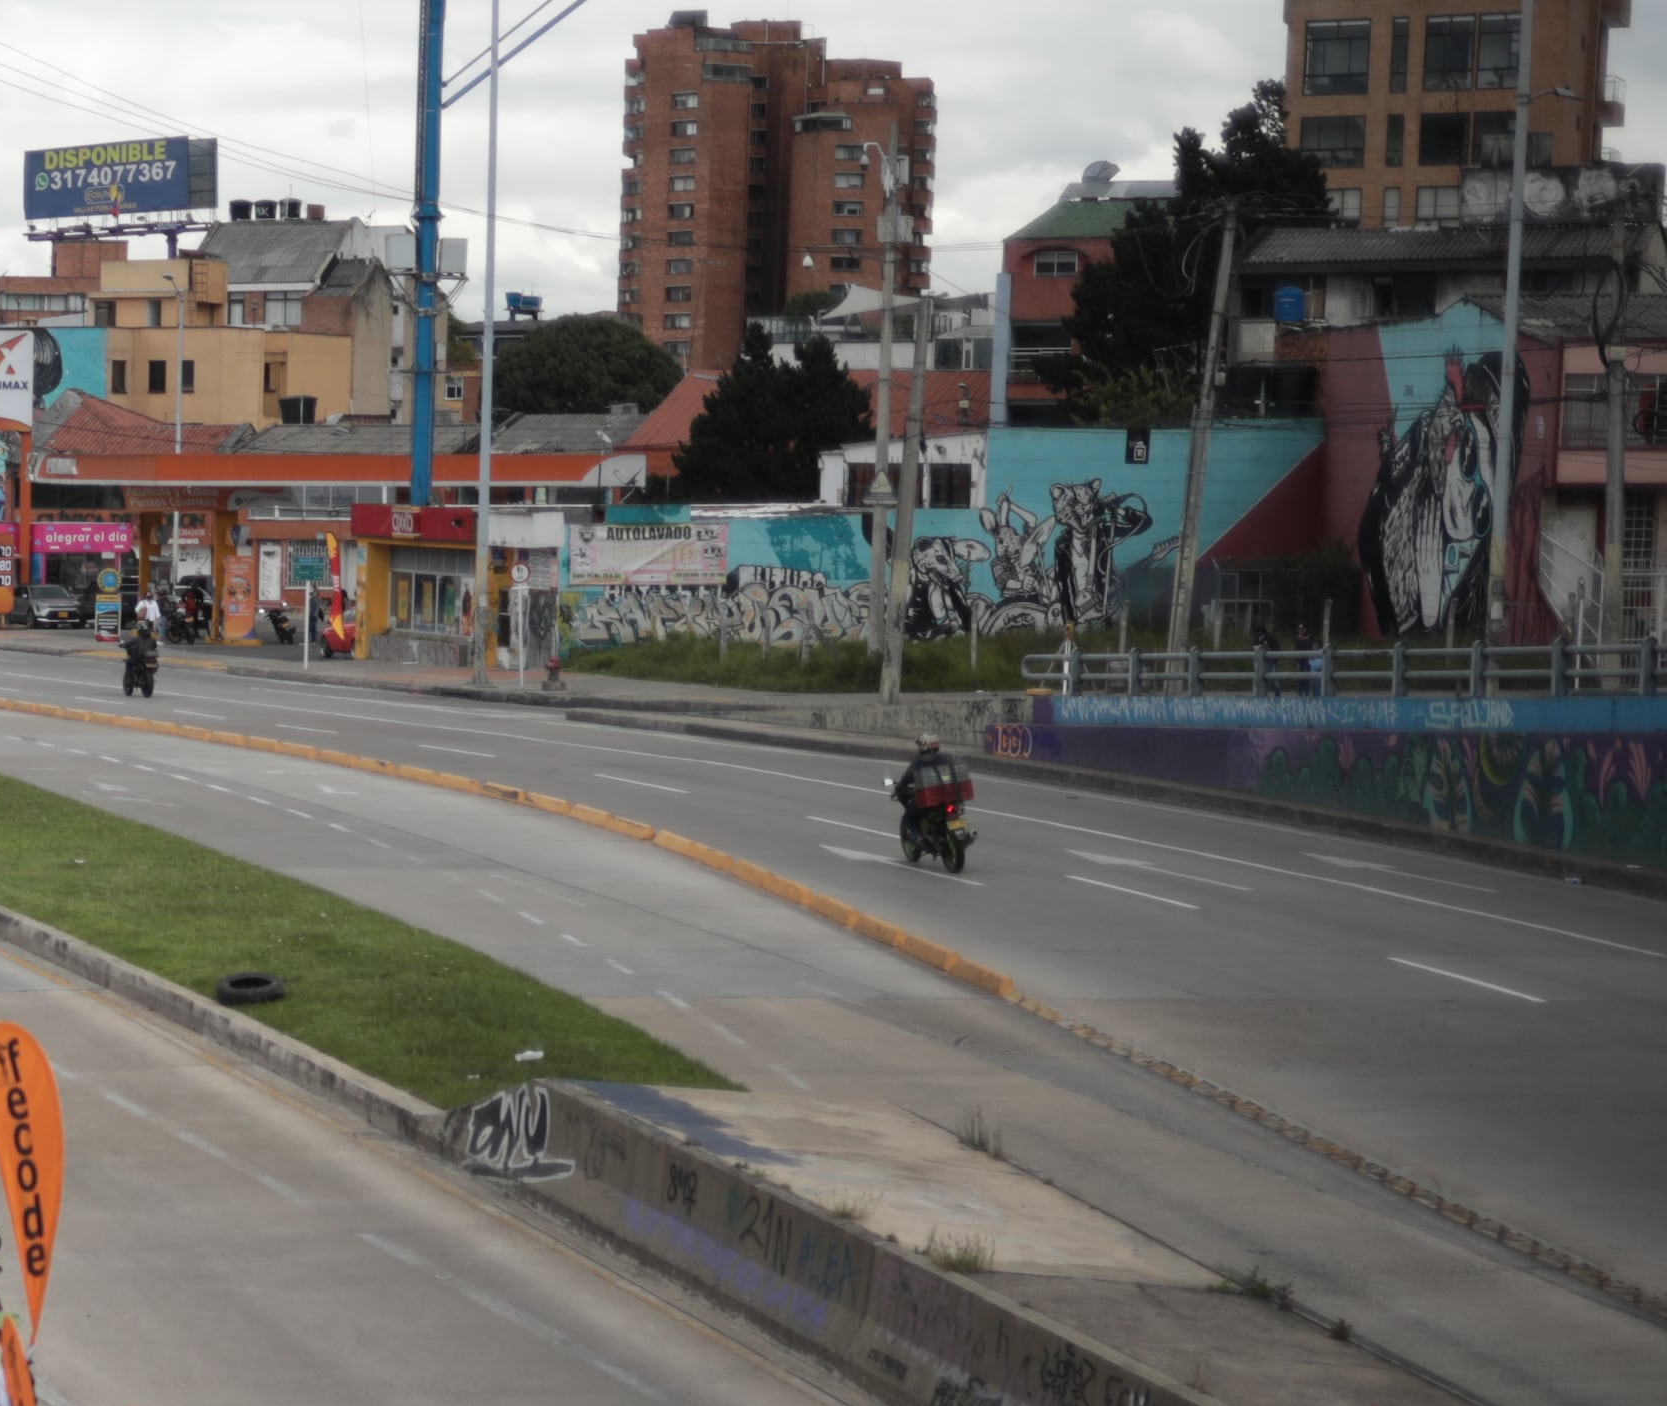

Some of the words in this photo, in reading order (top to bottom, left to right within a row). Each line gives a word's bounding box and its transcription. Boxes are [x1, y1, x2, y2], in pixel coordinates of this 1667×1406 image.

[44, 140, 167, 170] DISPONIBLE
[50, 161, 177, 190] 3174077367
[392, 512, 414, 532] OXXO
[605, 526, 692, 541] AUTOLAVADO
[46, 532, 90, 545] alegrar
[94, 532, 105, 543] el
[114, 532, 128, 543] día
[6, 1037, 48, 1278] fecode
